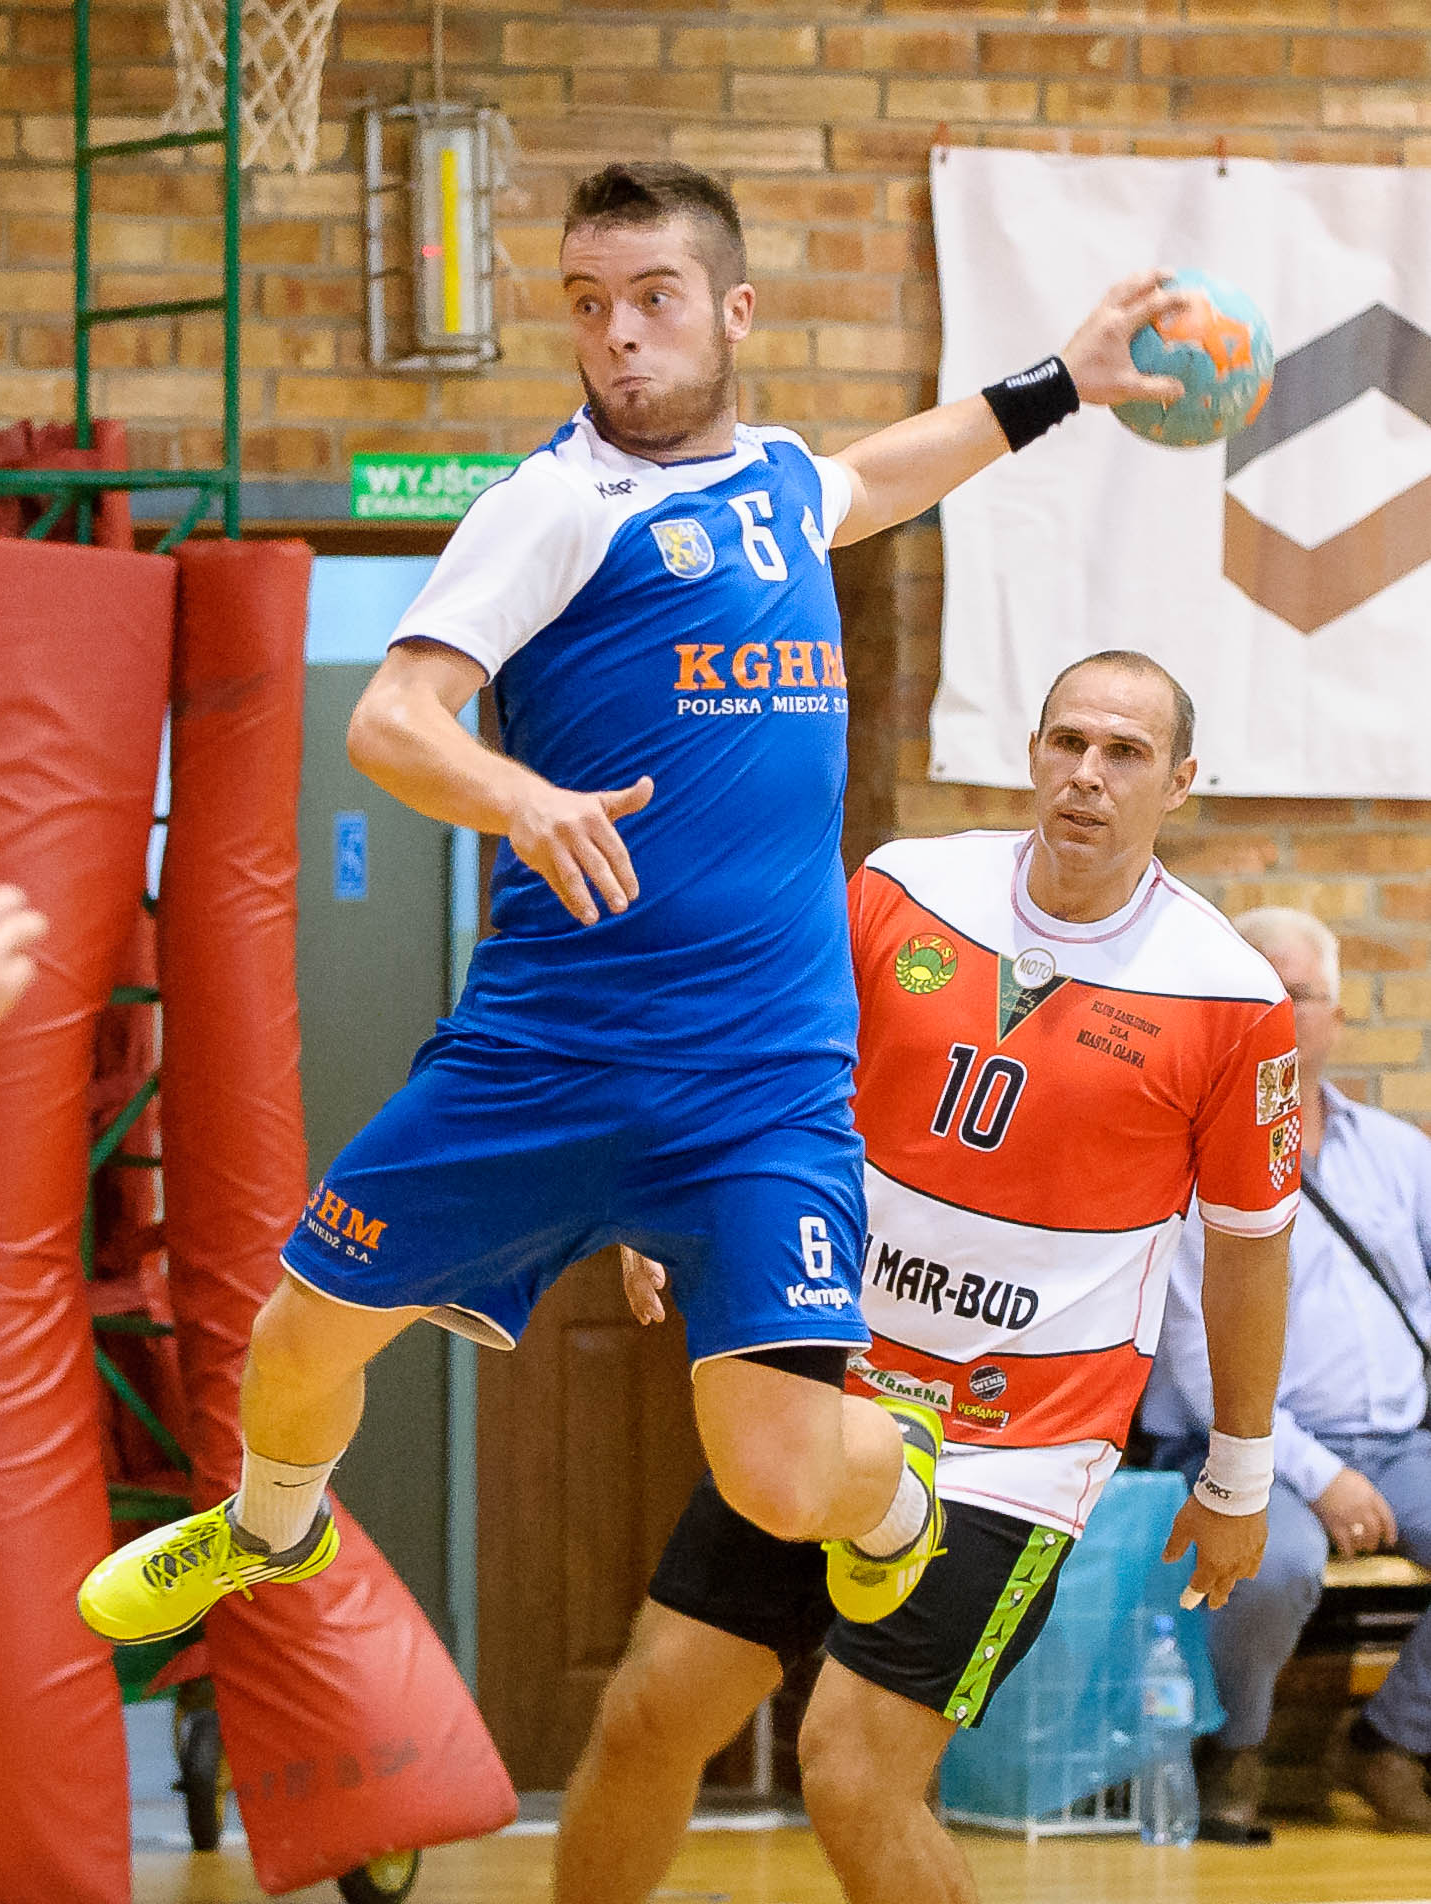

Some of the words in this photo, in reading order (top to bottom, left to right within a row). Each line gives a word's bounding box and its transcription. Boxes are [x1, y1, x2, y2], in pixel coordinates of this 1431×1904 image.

[727, 490, 788, 582] 6
[673, 640, 848, 690] KGHM
[676, 698, 762, 715] POLSKA
[771, 693, 829, 713] MIEDŹ
[1018, 957, 1052, 981] MOTO
[1076, 1028, 1113, 1055] MIASTA
[1112, 1042, 1147, 1070] OŁAWA
[1108, 1023, 1130, 1042] DLA
[931, 1042, 1028, 1152] 10
[798, 1215, 833, 1280] 6
[871, 1241, 1040, 1331] MAR-BUD
